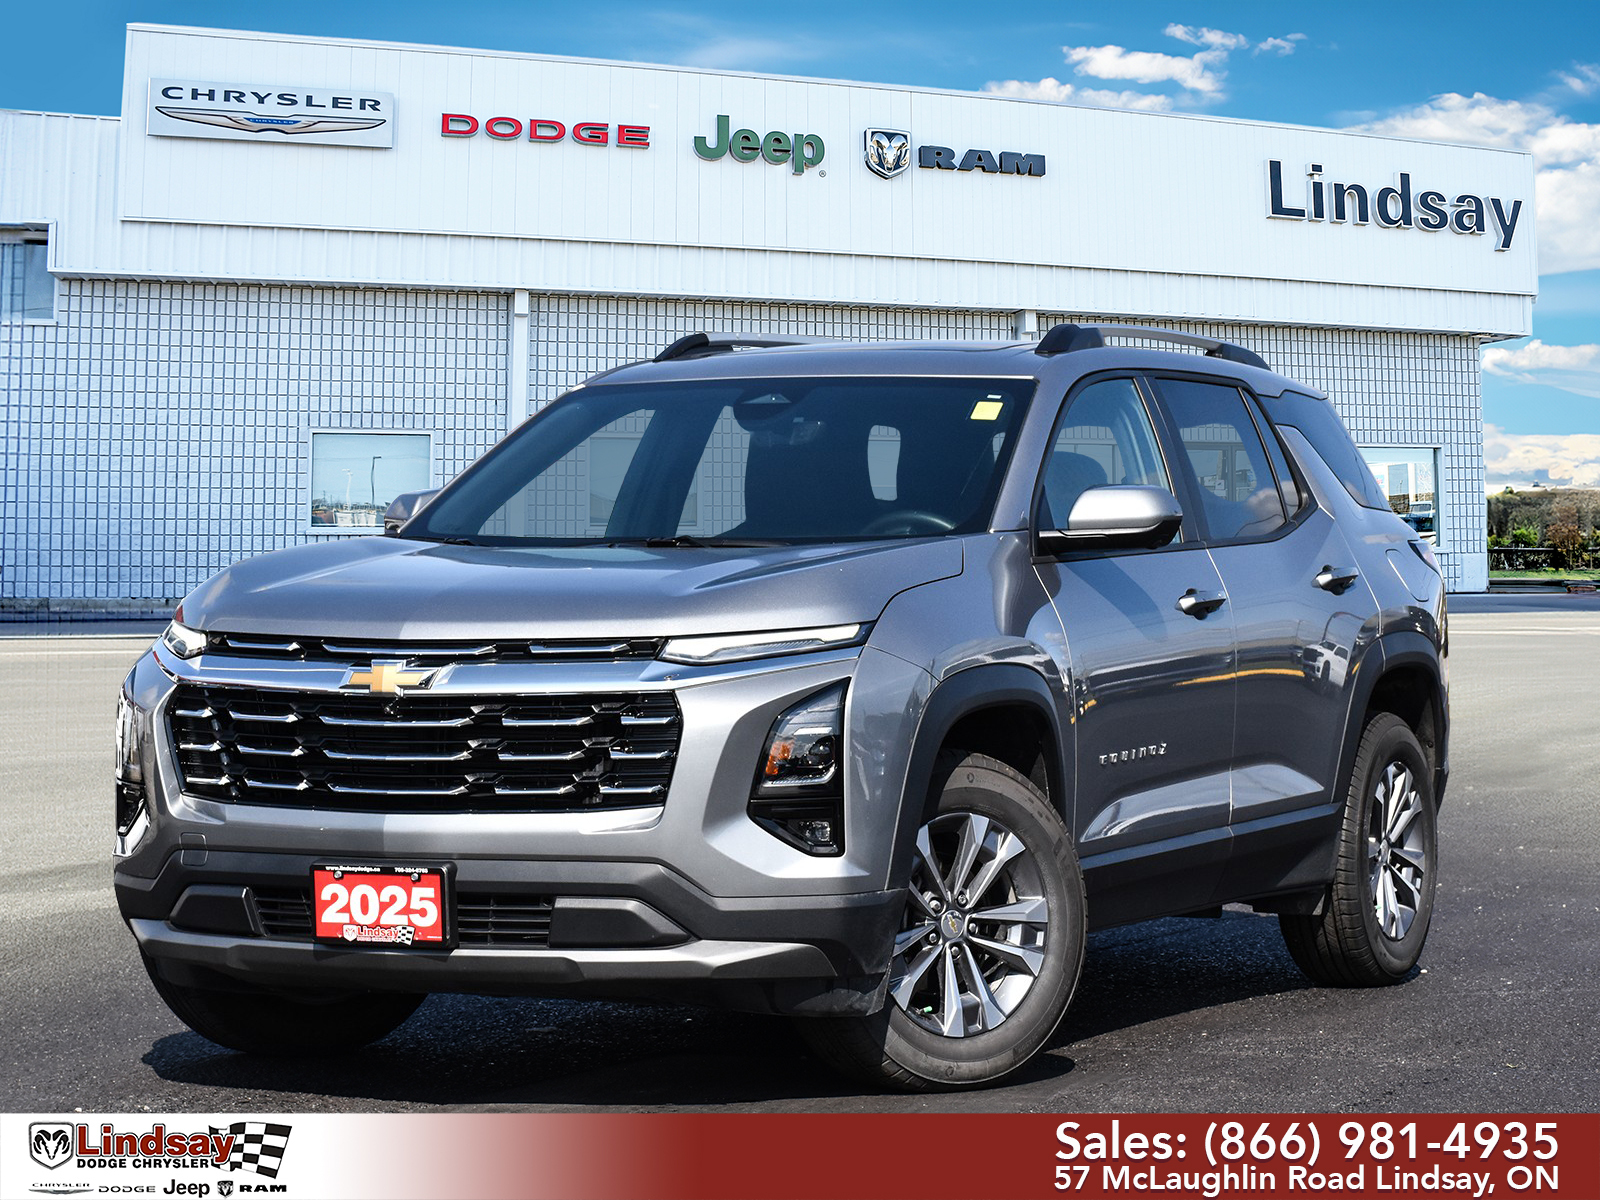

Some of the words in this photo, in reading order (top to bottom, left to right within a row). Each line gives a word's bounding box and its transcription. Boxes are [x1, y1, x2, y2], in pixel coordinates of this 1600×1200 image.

[161, 86, 381, 112] CHRYSLER
[441, 112, 651, 149] DODGE
[693, 114, 825, 175] Jeep
[918, 145, 1046, 177] RAM
[1265, 158, 1524, 252] Lindsay
[321, 883, 438, 927] 2025
[357, 925, 399, 939] Lindsay
